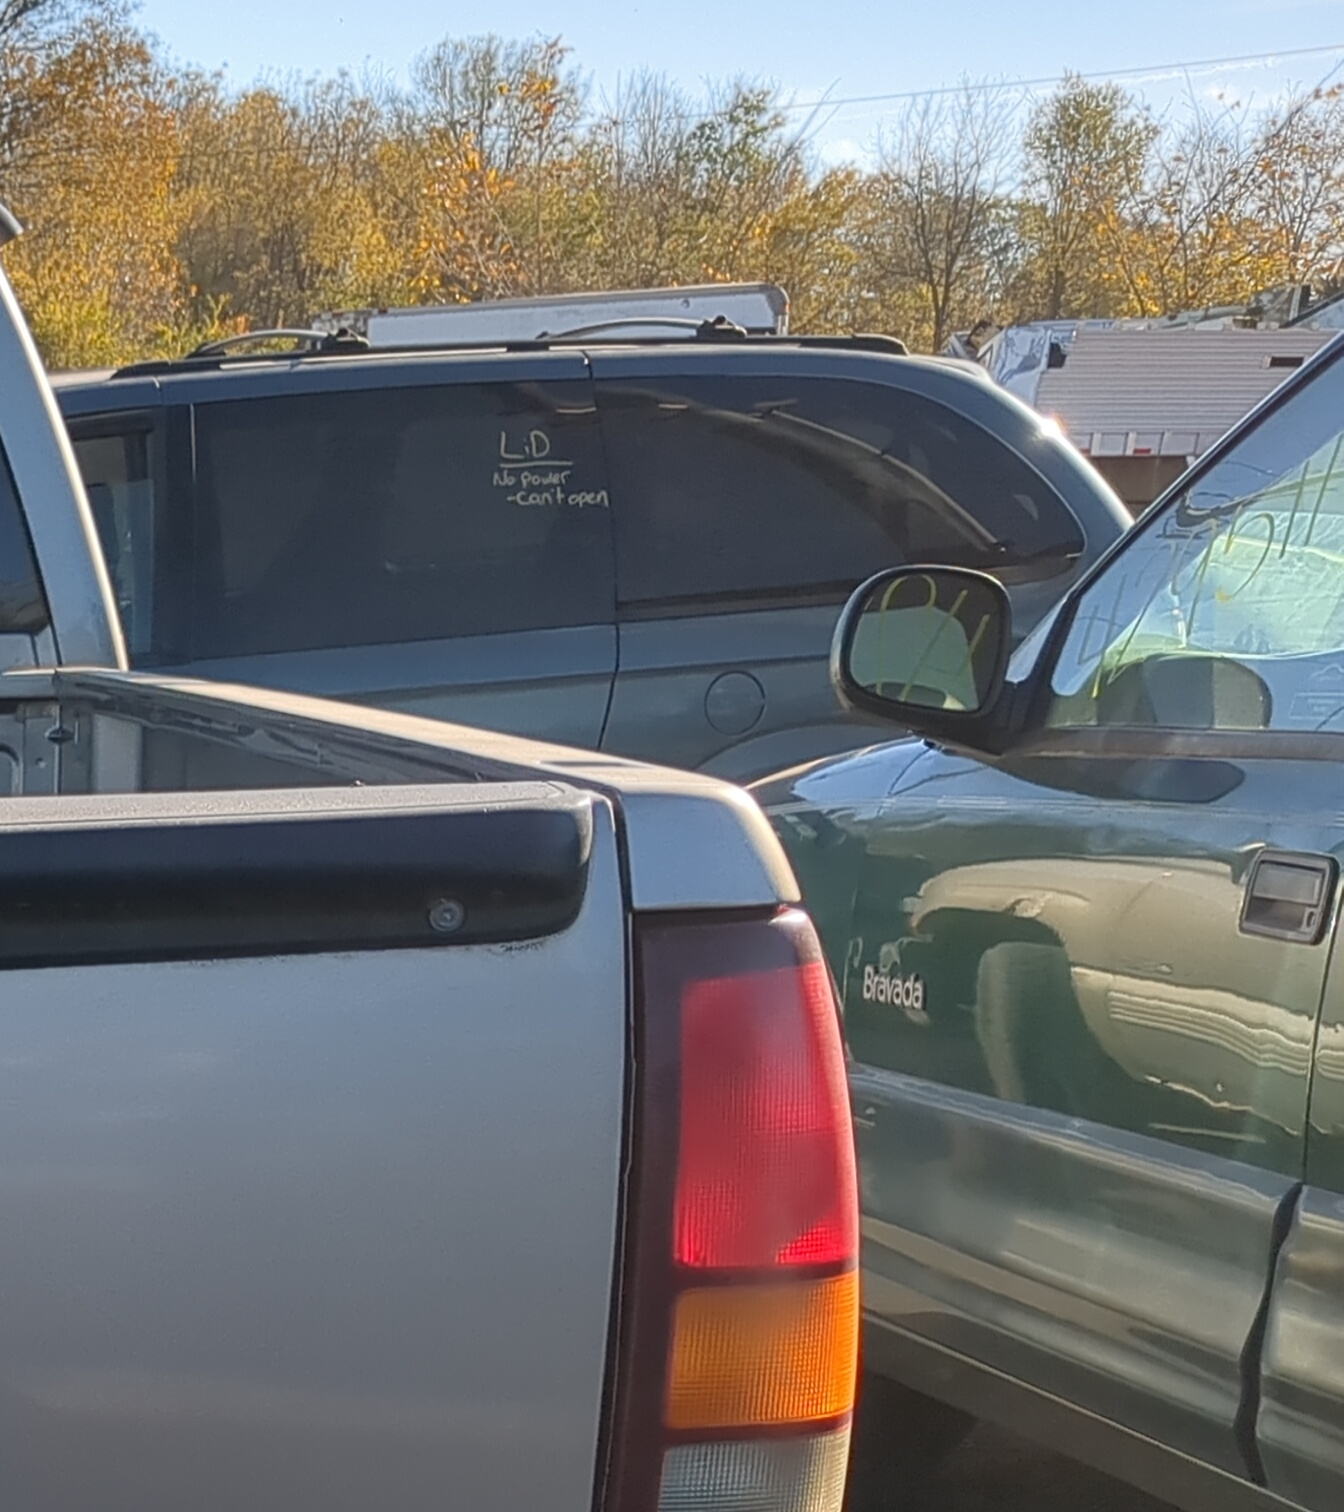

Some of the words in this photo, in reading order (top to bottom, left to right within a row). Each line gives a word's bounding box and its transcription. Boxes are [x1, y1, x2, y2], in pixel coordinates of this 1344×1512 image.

[493, 470, 516, 486] No
[567, 489, 609, 507] open
[863, 964, 925, 1011] Bravada
